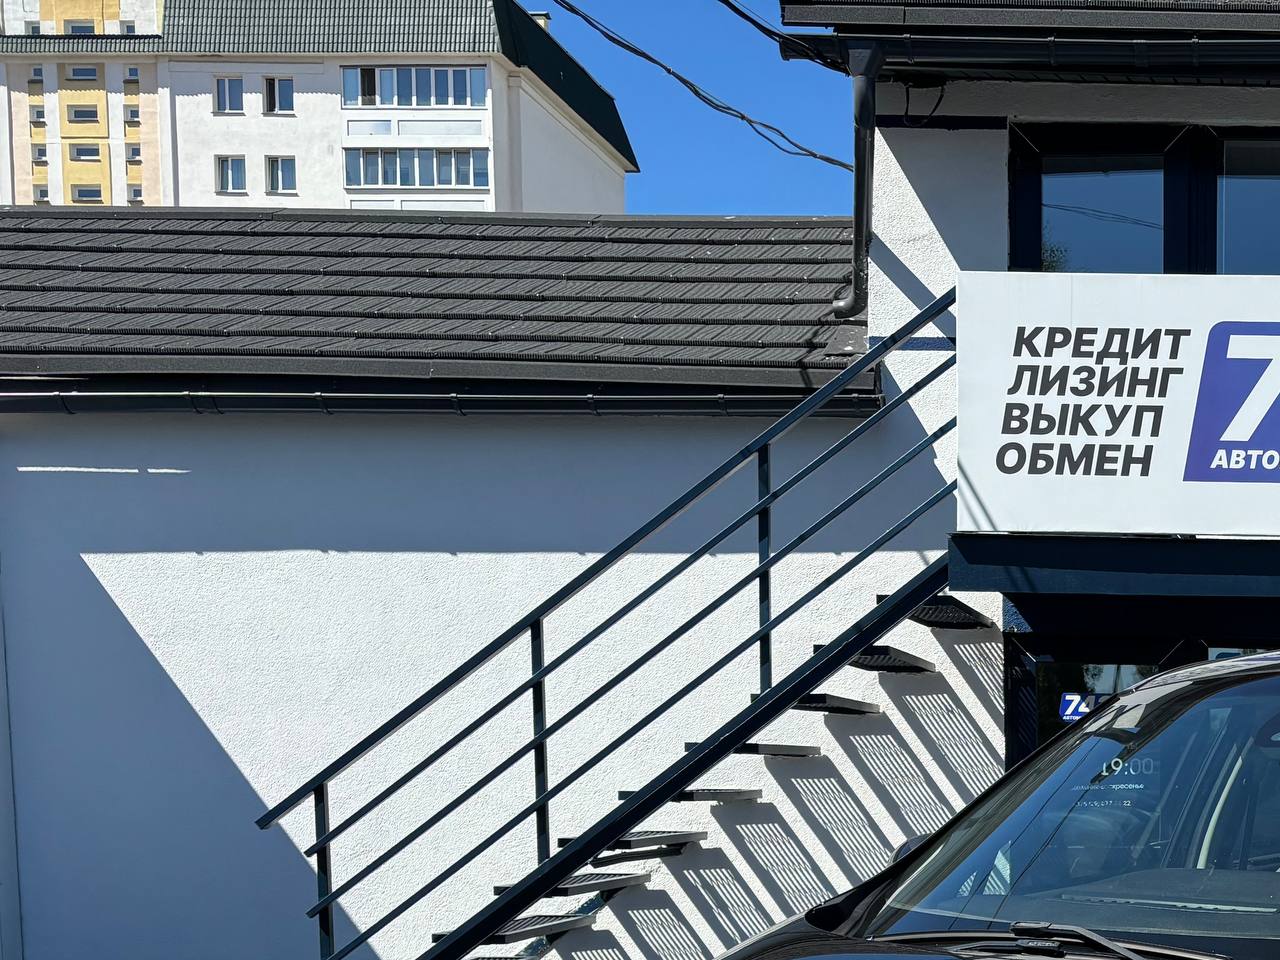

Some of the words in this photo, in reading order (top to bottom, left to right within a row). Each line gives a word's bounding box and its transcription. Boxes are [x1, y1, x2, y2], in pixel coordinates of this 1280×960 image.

[1012, 326, 1191, 365] КРЕДИТ
[1006, 364, 1184, 398] ЛИЗИНГ
[1000, 402, 1164, 438] ВЫКУП
[995, 441, 1154, 477] ОБМЕН
